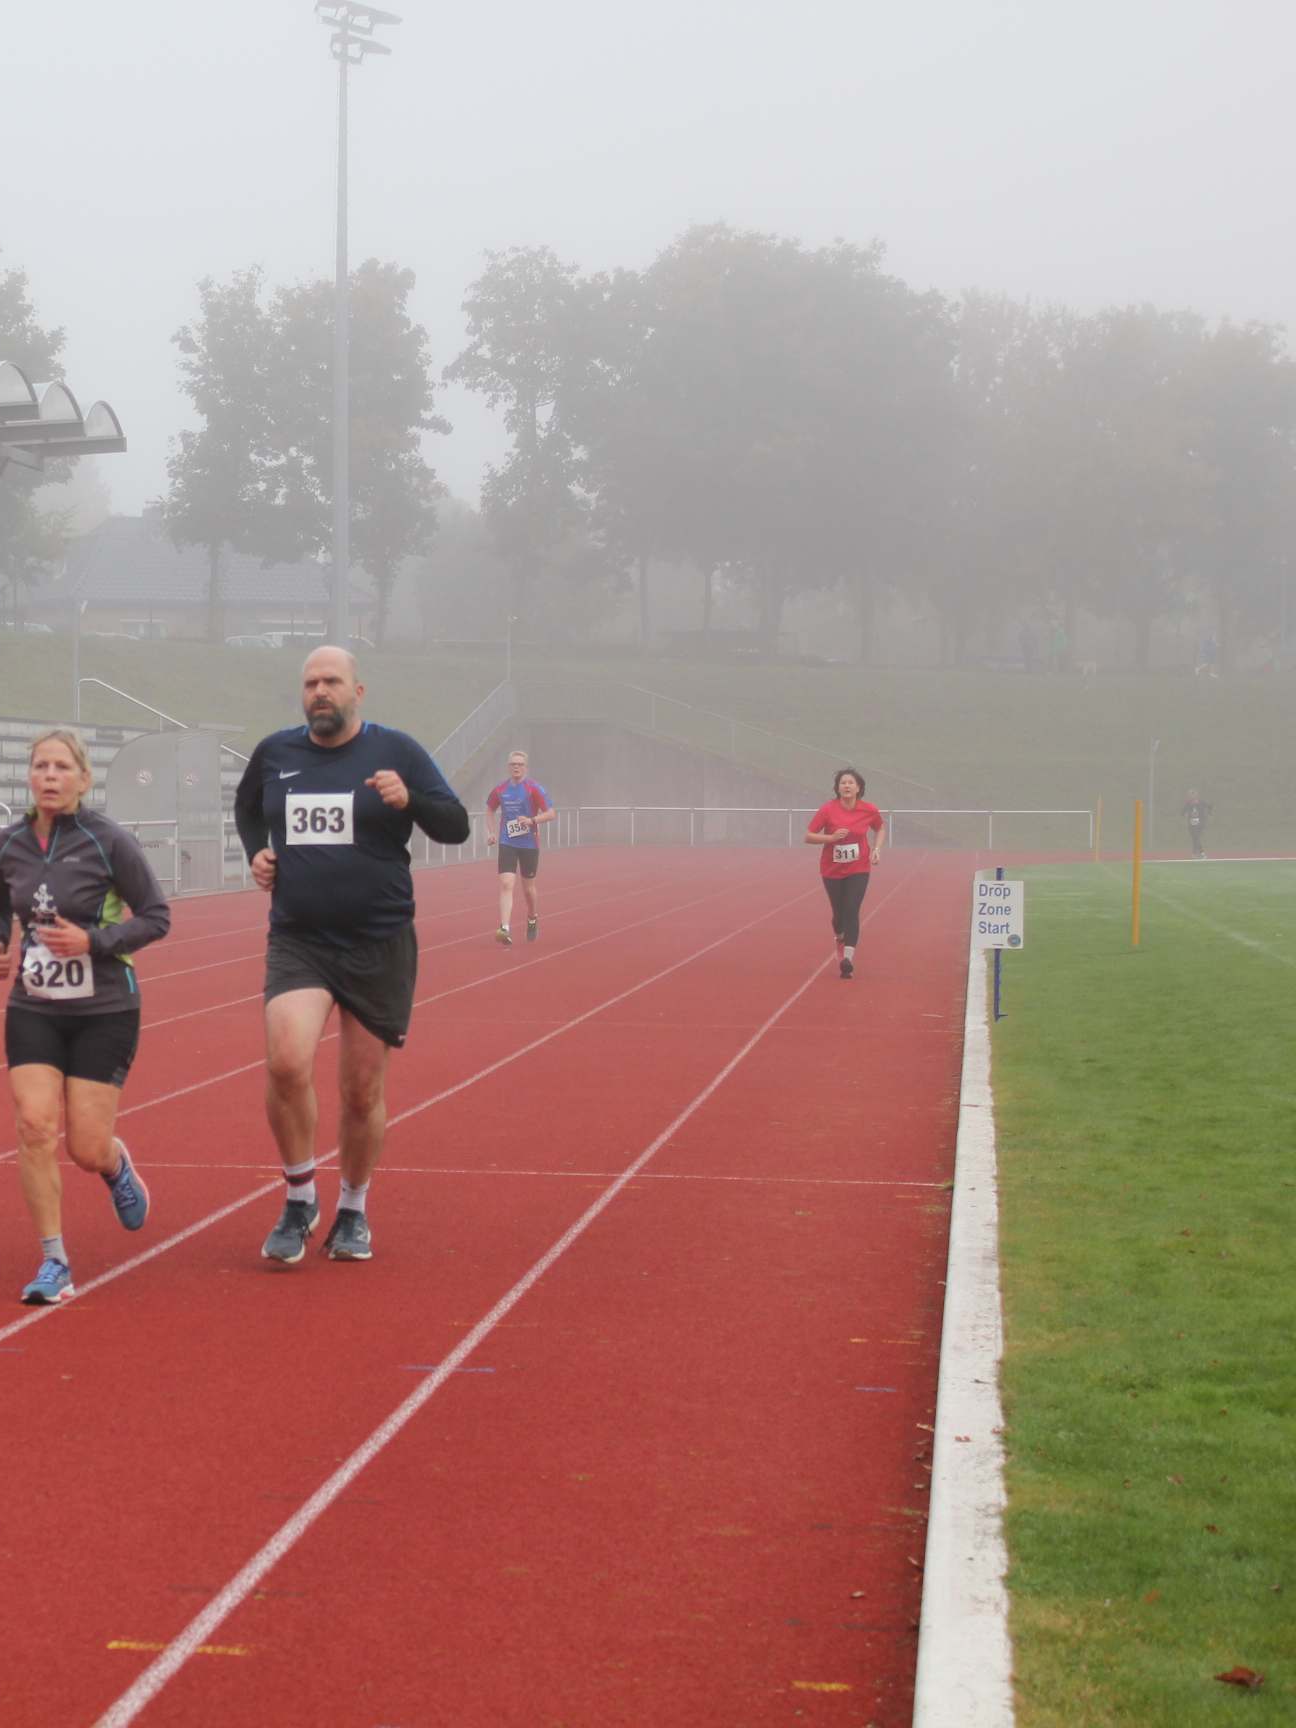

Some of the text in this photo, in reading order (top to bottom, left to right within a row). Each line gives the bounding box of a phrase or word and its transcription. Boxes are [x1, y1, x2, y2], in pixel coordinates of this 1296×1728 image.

[292, 806, 345, 834] 363
[835, 848, 856, 860] 311
[978, 883, 1011, 900] Drop
[977, 902, 1012, 916] Zone
[978, 920, 1011, 935] Start
[30, 959, 84, 988] 320
